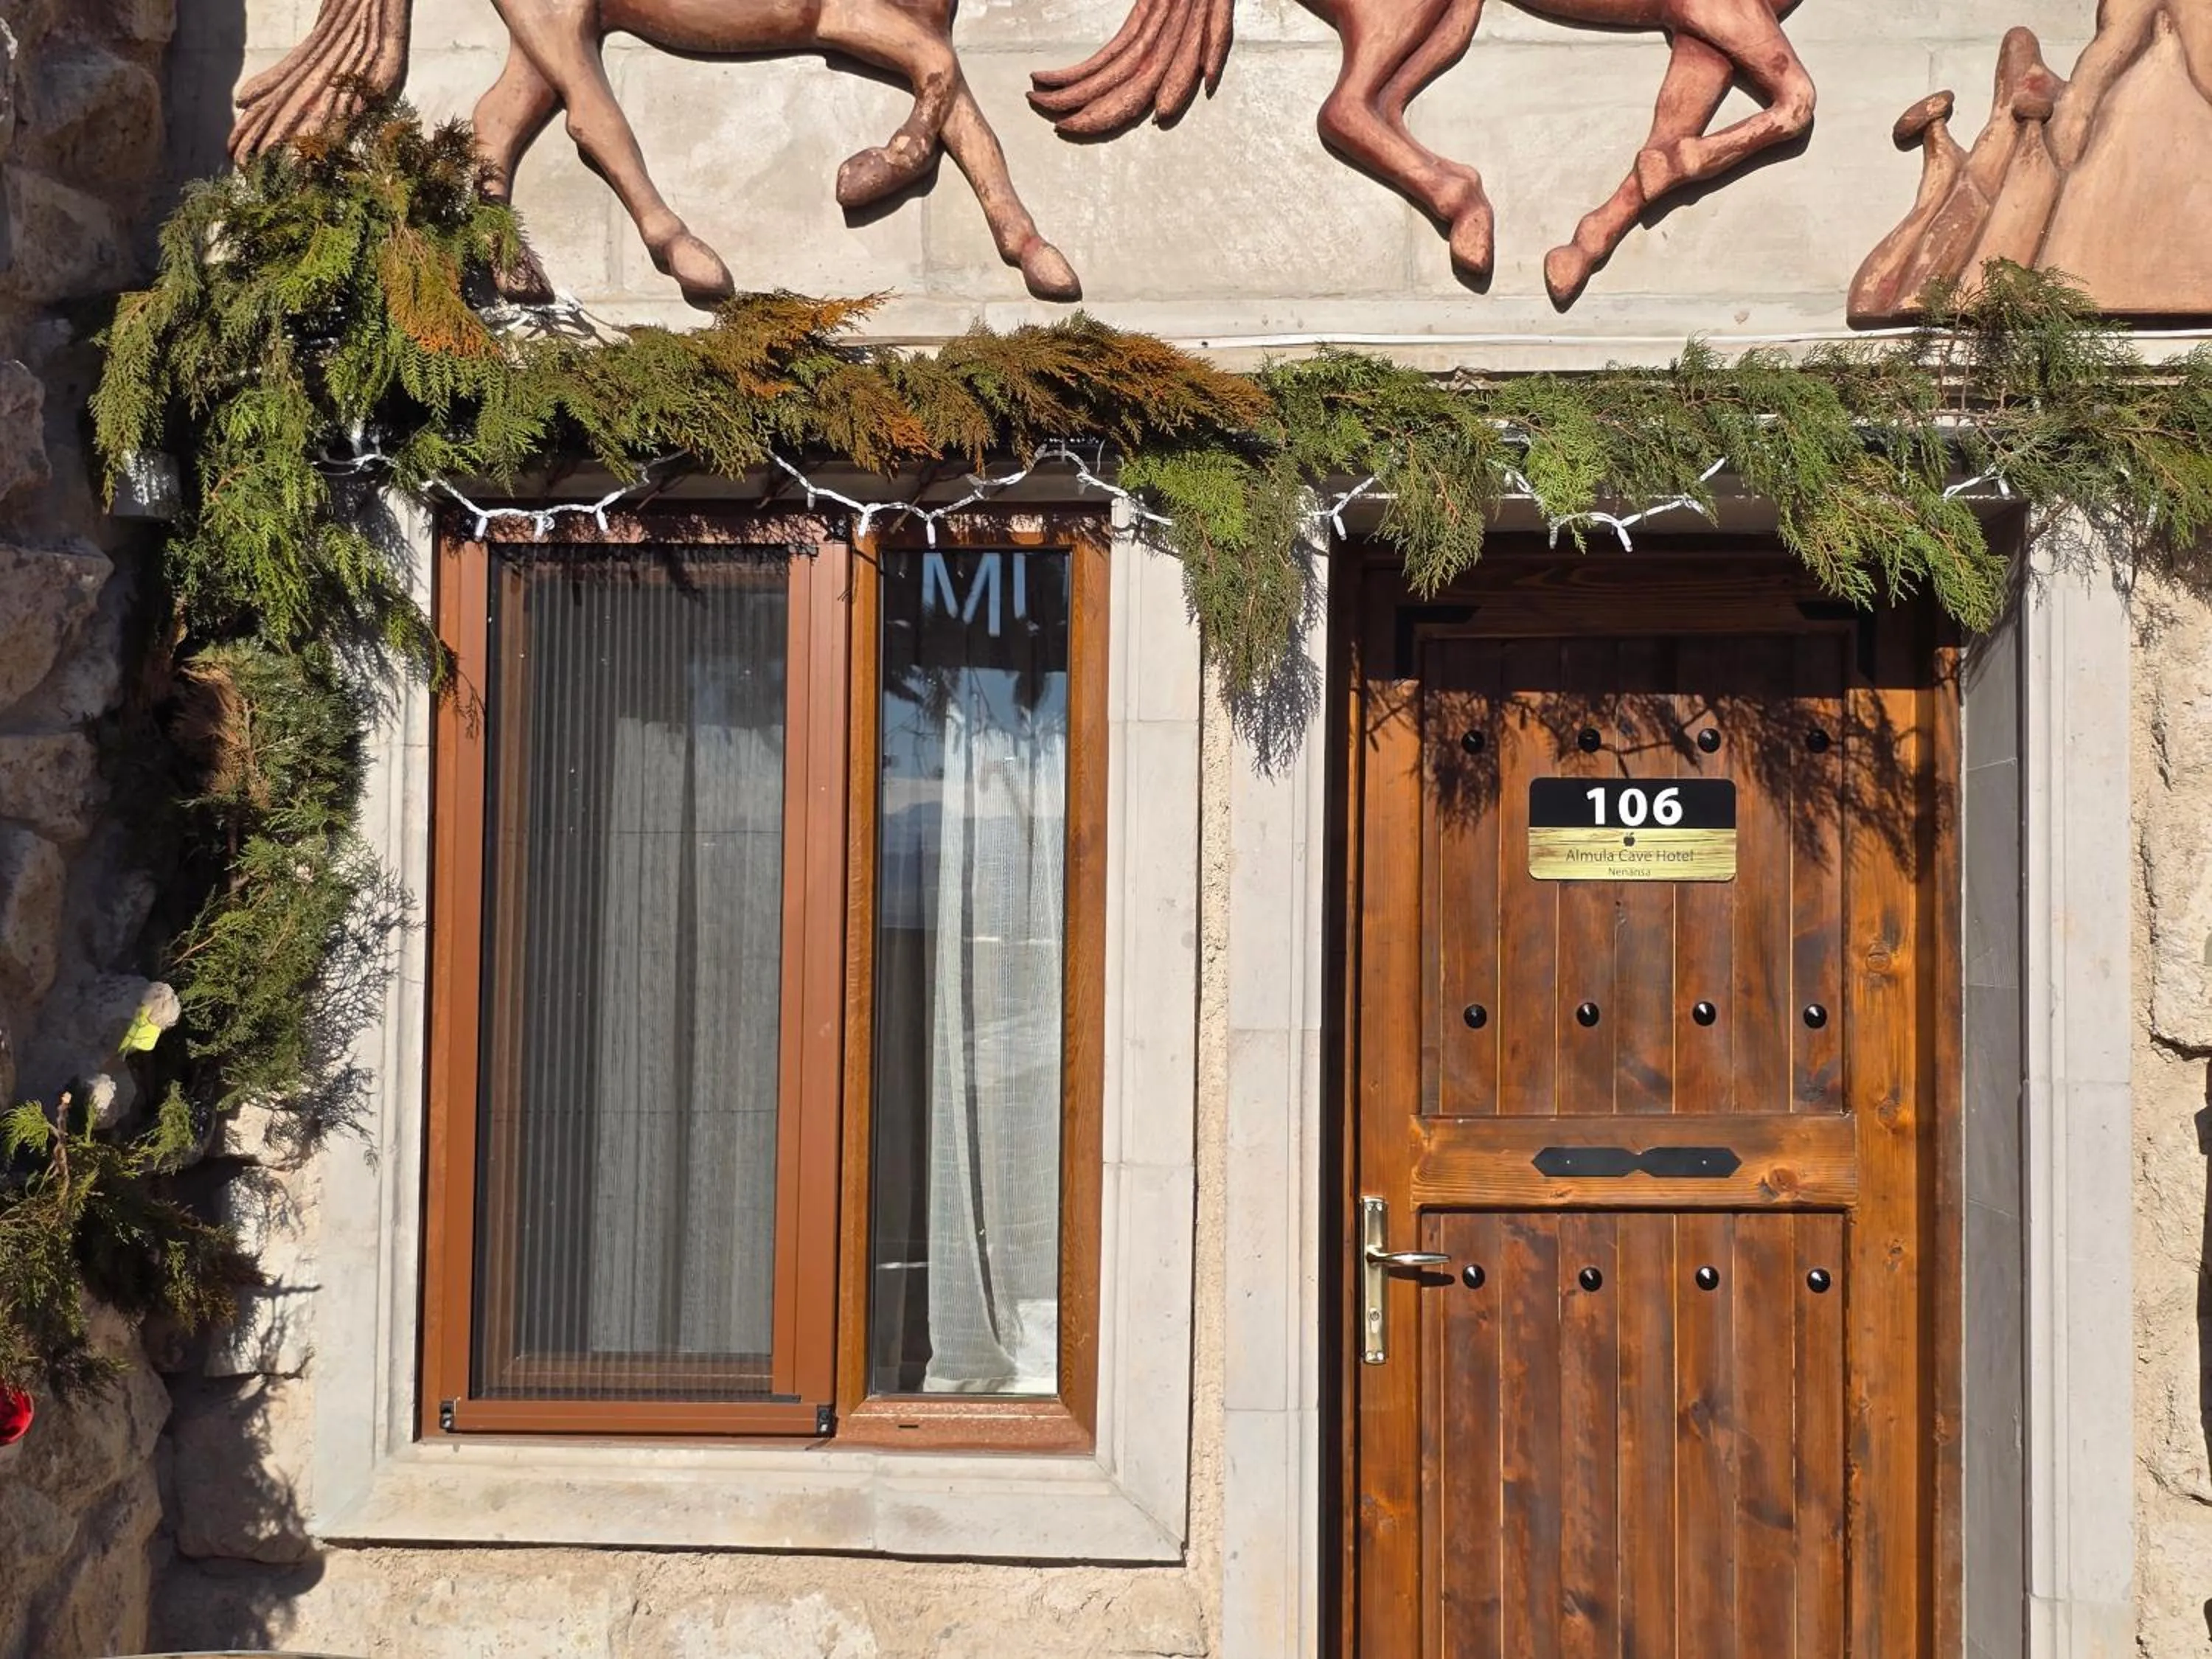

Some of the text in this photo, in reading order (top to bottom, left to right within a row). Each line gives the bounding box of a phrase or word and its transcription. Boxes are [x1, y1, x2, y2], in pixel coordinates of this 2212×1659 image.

[1586, 787, 1683, 827] 106
[1565, 849, 1694, 863] Almula Cave Hotel
